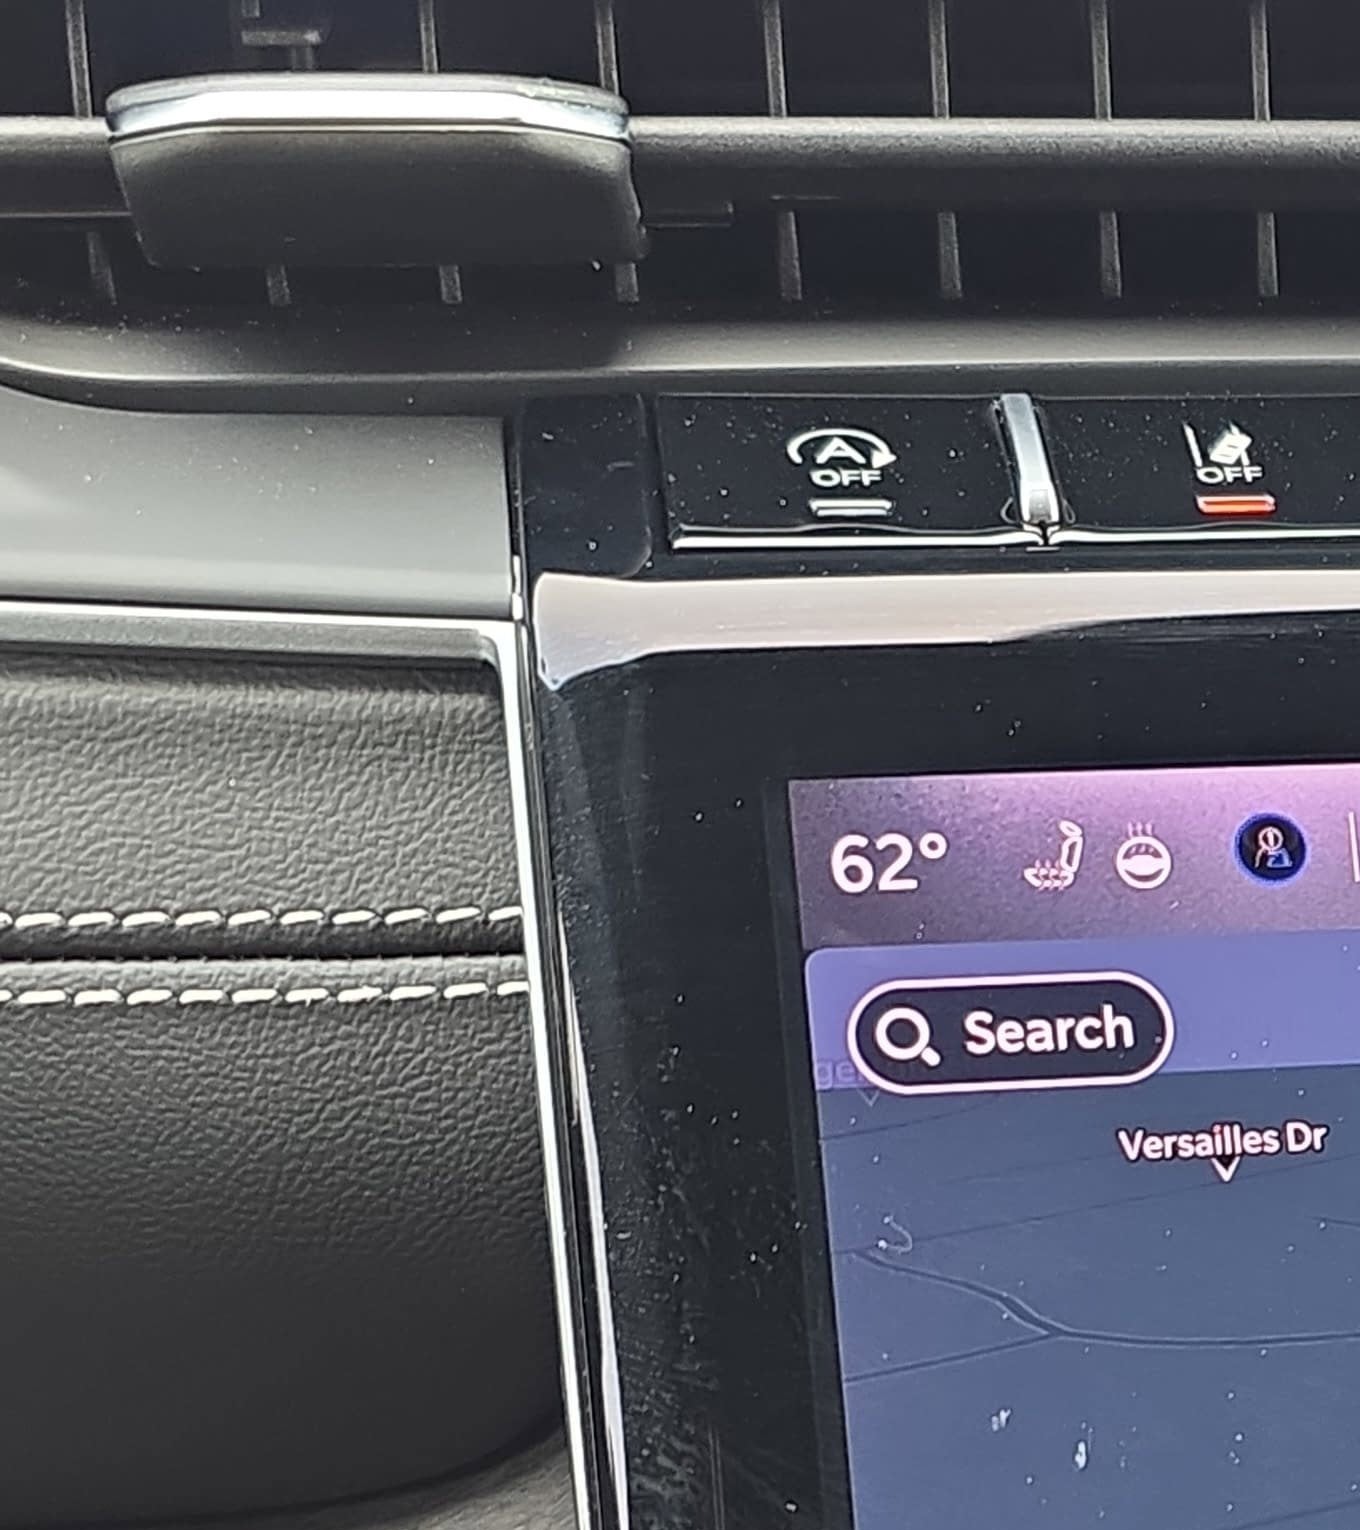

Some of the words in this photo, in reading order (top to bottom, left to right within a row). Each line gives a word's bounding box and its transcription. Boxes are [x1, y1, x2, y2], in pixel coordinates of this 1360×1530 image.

[809, 468, 882, 488] OFF
[1196, 465, 1263, 484] OFF
[829, 832, 949, 893] 62°
[962, 1004, 1136, 1056] Search
[1118, 1124, 1281, 1161] Versailles
[1286, 1121, 1328, 1152] Dr
